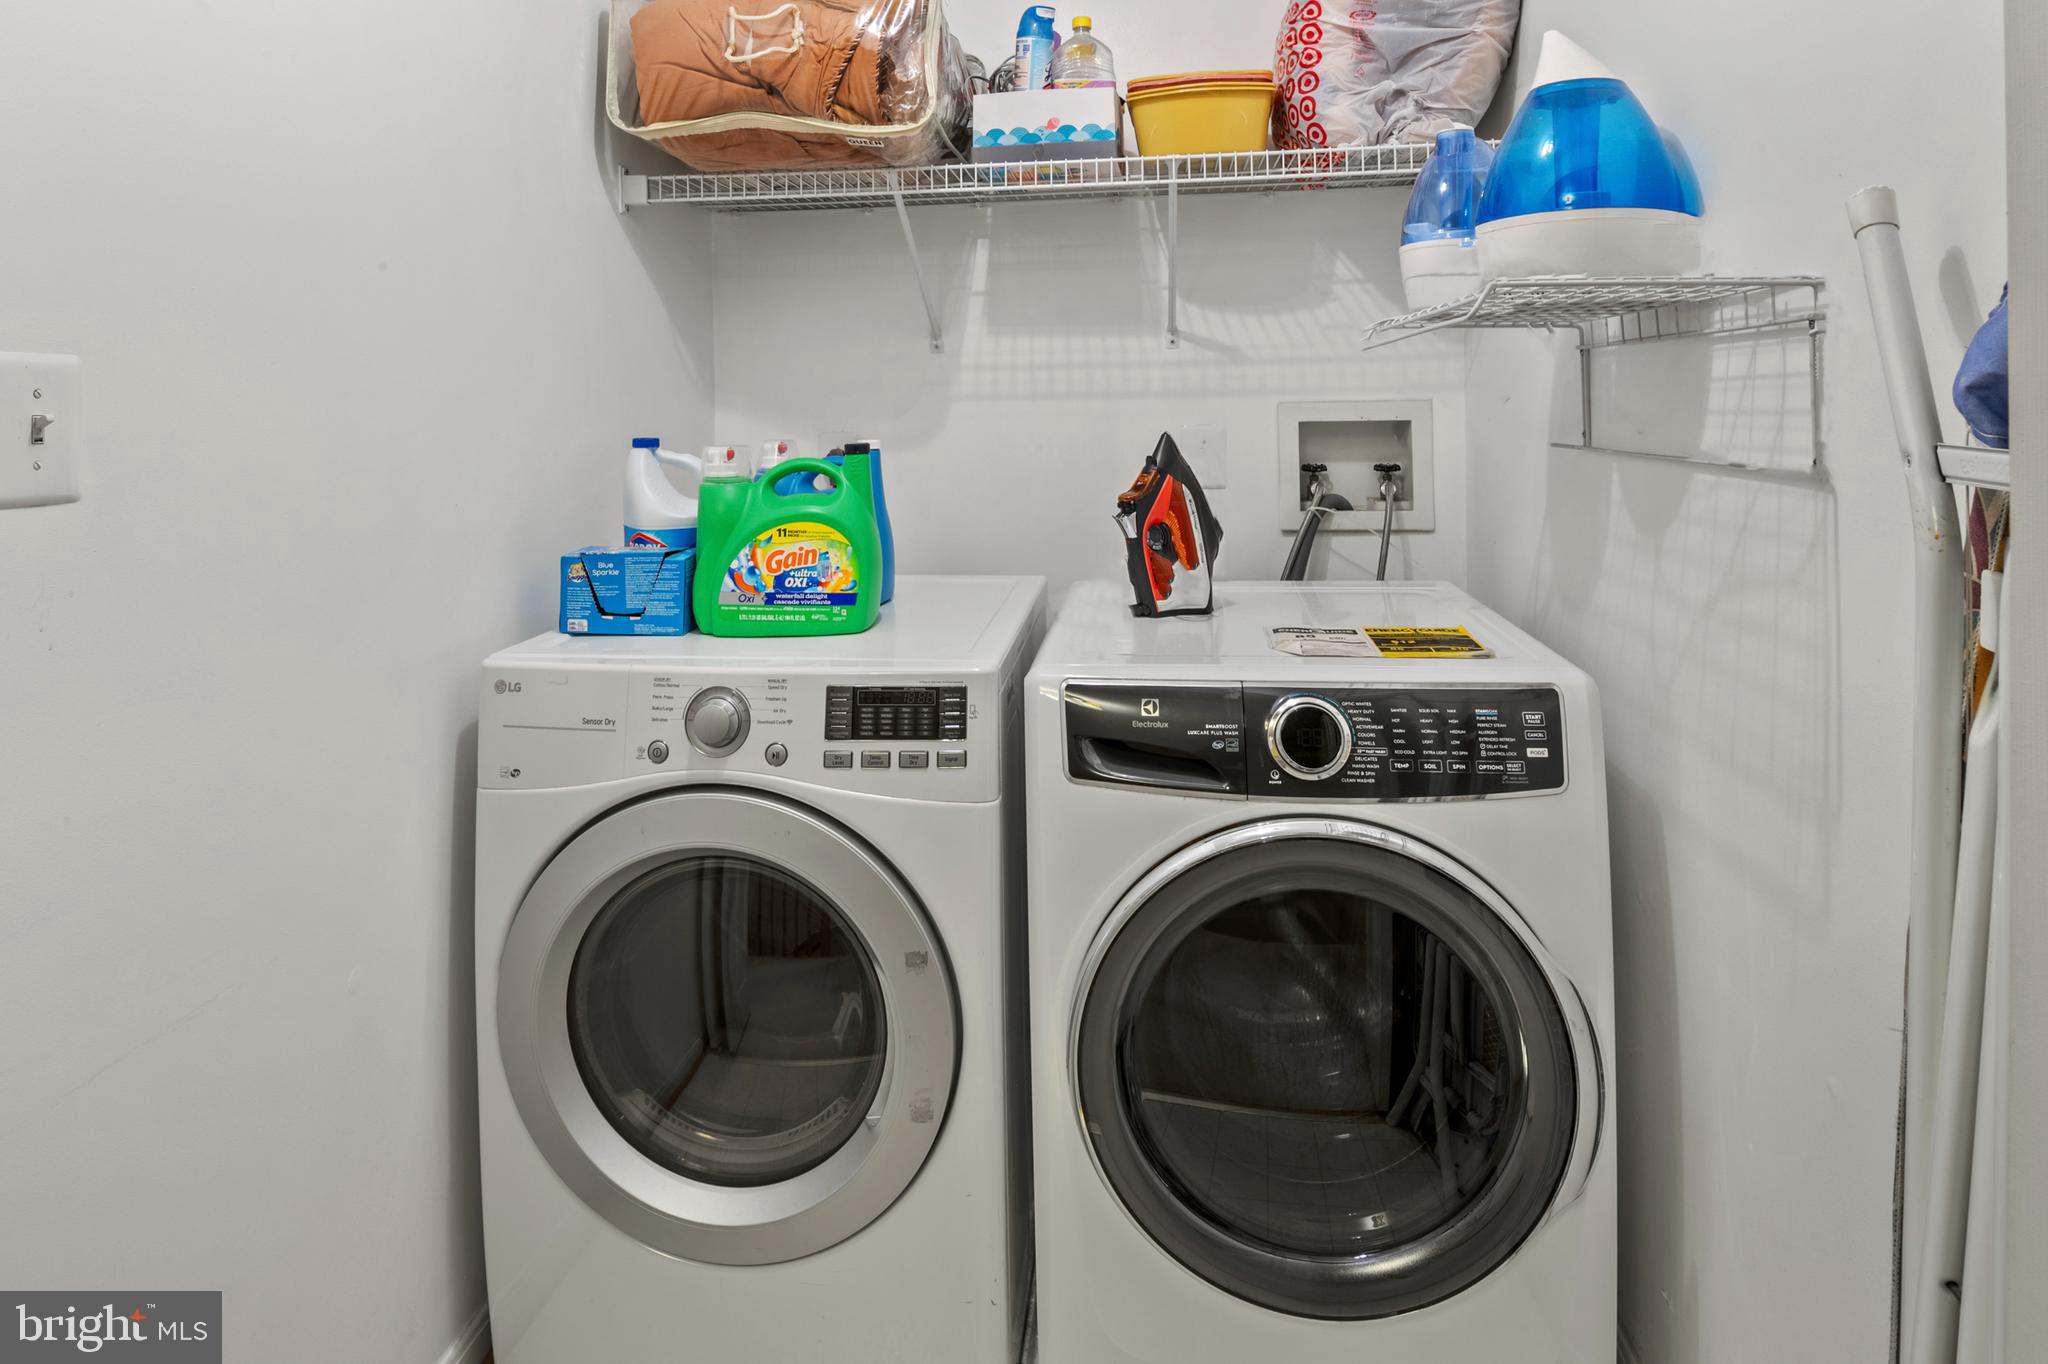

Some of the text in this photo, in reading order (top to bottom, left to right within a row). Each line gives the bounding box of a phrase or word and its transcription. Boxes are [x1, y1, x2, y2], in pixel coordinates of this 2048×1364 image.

[777, 528, 787, 537] 11
[765, 546, 818, 575] Gain
[592, 569, 620, 577] Sparkle
[738, 594, 755, 603] Oxi
[508, 682, 522, 693] LG
[582, 717, 616, 727] Sensor Dry
[1132, 720, 1168, 728] Electrolux
